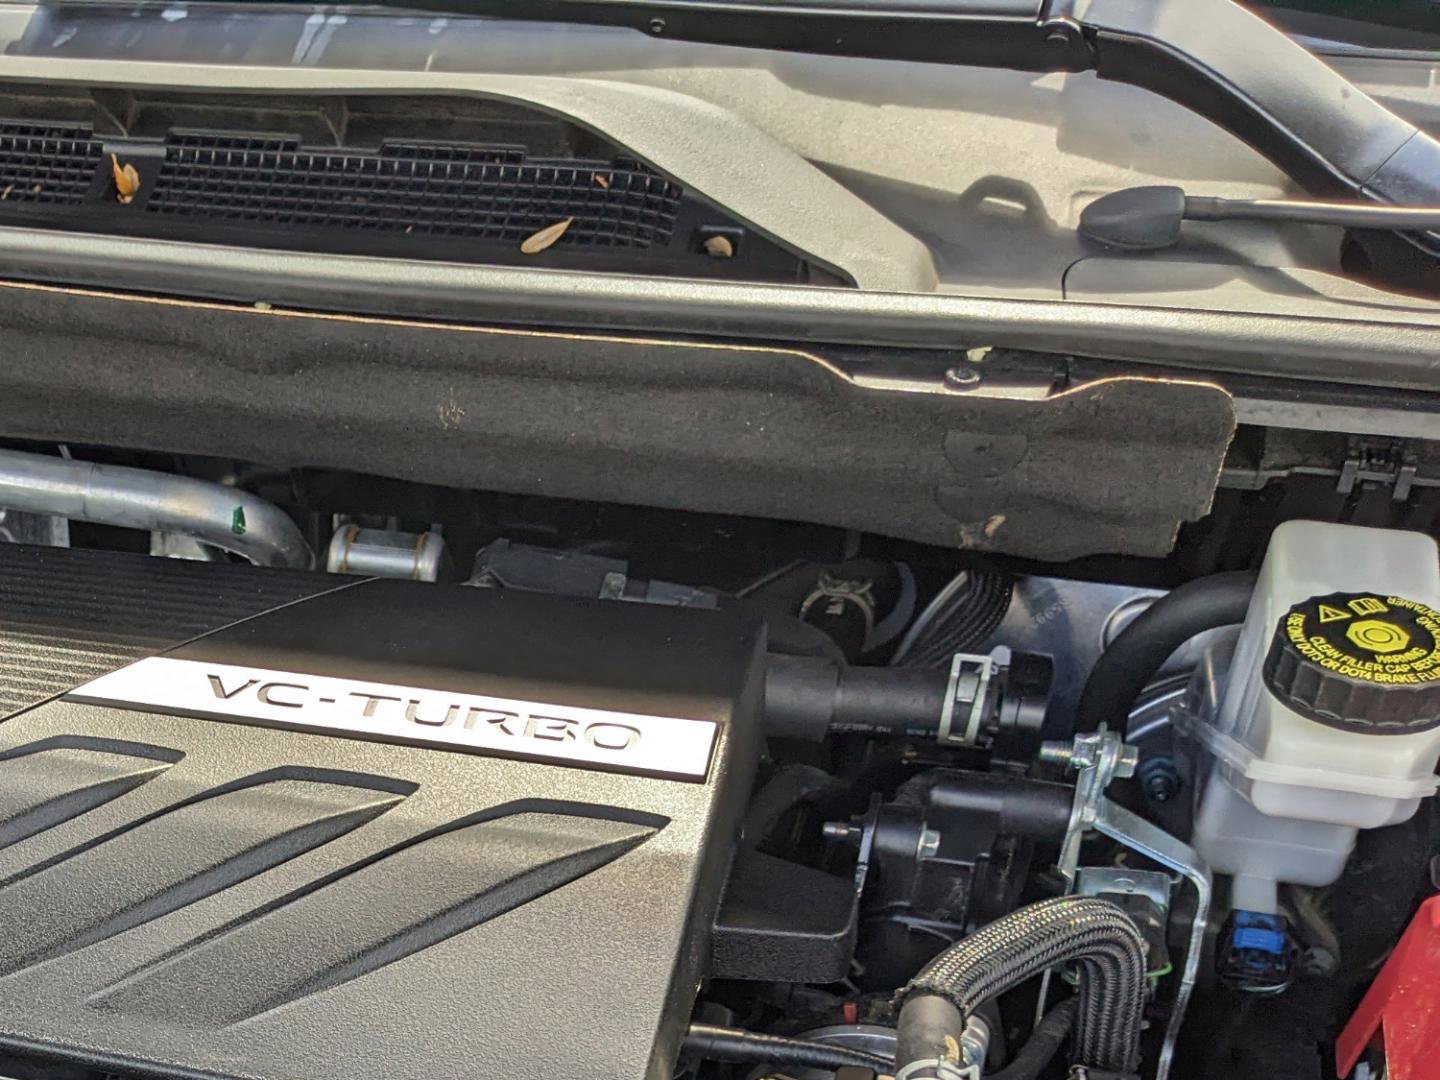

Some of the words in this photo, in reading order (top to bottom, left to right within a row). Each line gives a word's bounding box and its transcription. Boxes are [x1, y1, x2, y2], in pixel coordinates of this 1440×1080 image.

[1374, 647, 1428, 663] WARNING
[1339, 655, 1384, 673] FILLER
[1384, 664, 1412, 674] CAP
[1374, 672, 1420, 684] BRAKE
[206, 673, 642, 751] VC-TURBO
